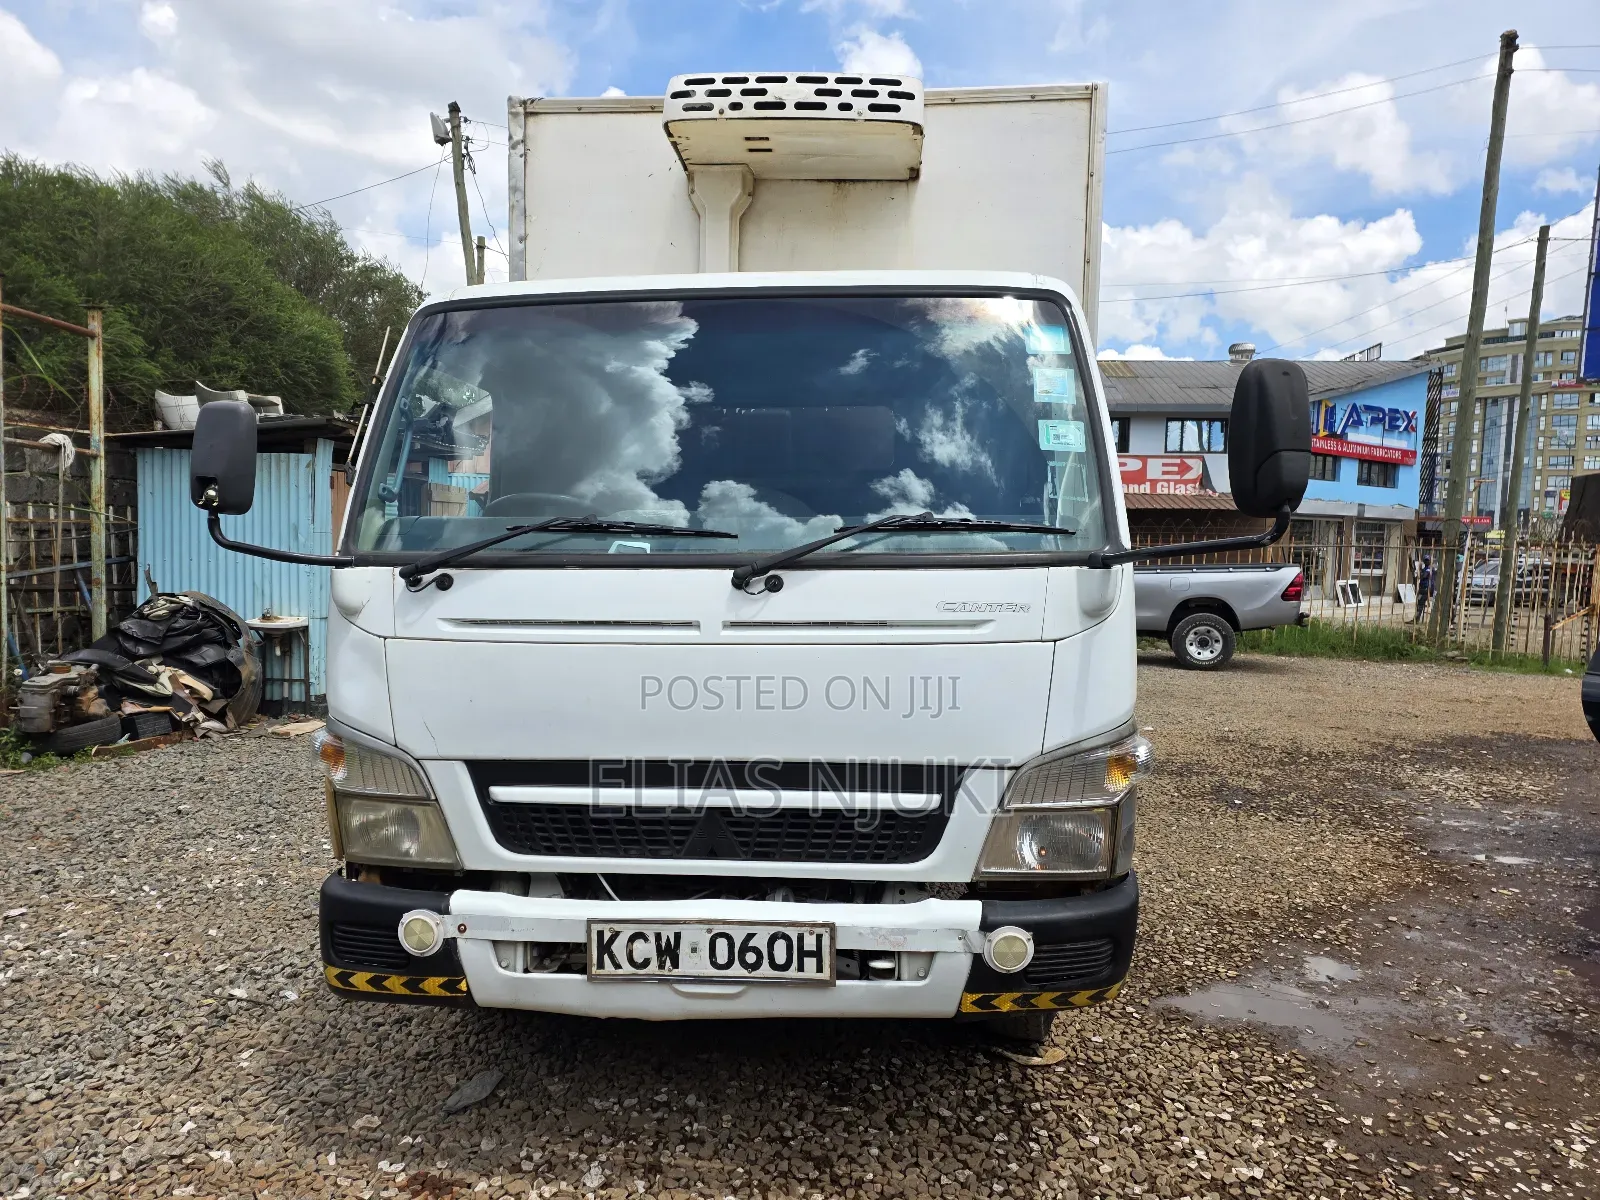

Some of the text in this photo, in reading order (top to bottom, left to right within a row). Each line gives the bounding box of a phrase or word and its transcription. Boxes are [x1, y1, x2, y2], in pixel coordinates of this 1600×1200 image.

[1336, 402, 1418, 435] APEX
[1370, 446, 1402, 459] FABRICATORS
[935, 600, 1031, 613] CANTER
[596, 929, 682, 971] KCW
[708, 931, 824, 974] 060H
